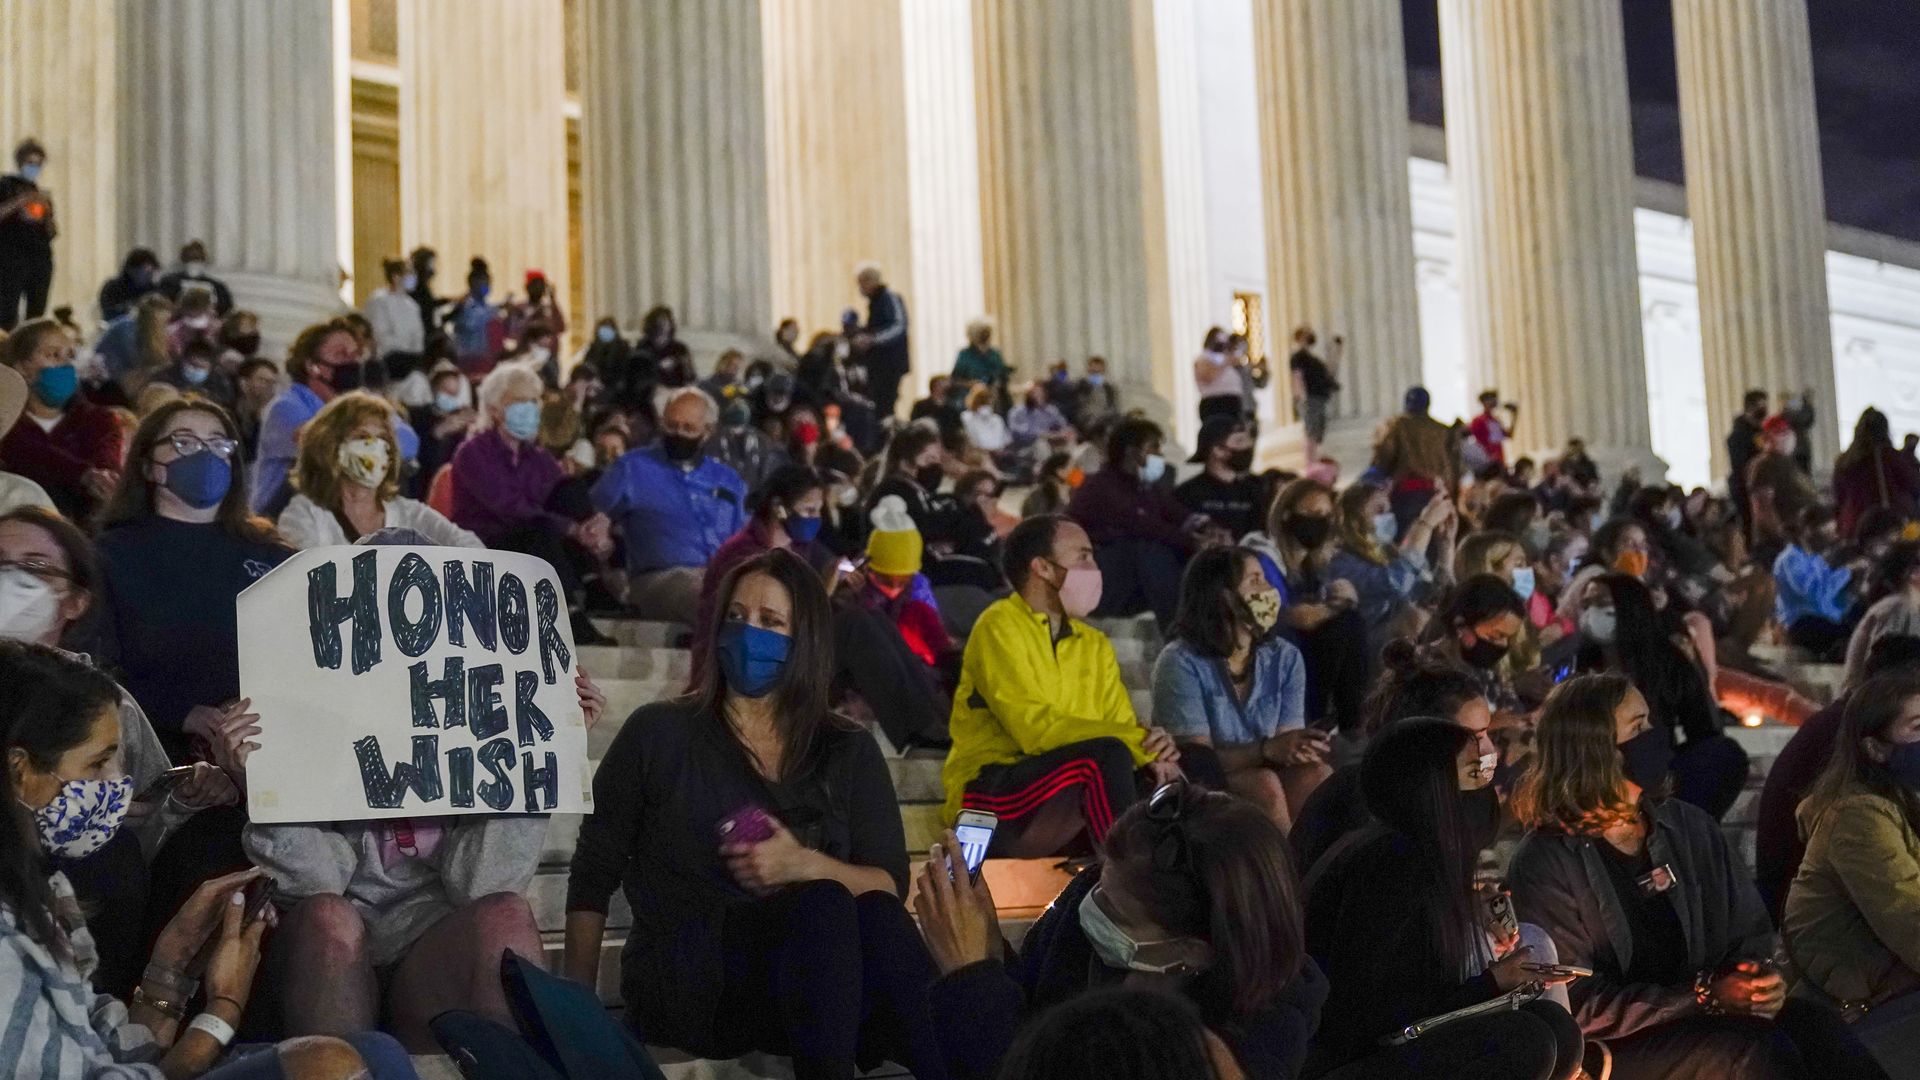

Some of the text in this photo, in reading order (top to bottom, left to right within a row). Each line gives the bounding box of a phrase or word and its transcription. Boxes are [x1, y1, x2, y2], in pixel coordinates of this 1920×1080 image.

[307, 549, 571, 684] HONOR
[408, 656, 555, 747] HER
[353, 735, 558, 812] WISH
